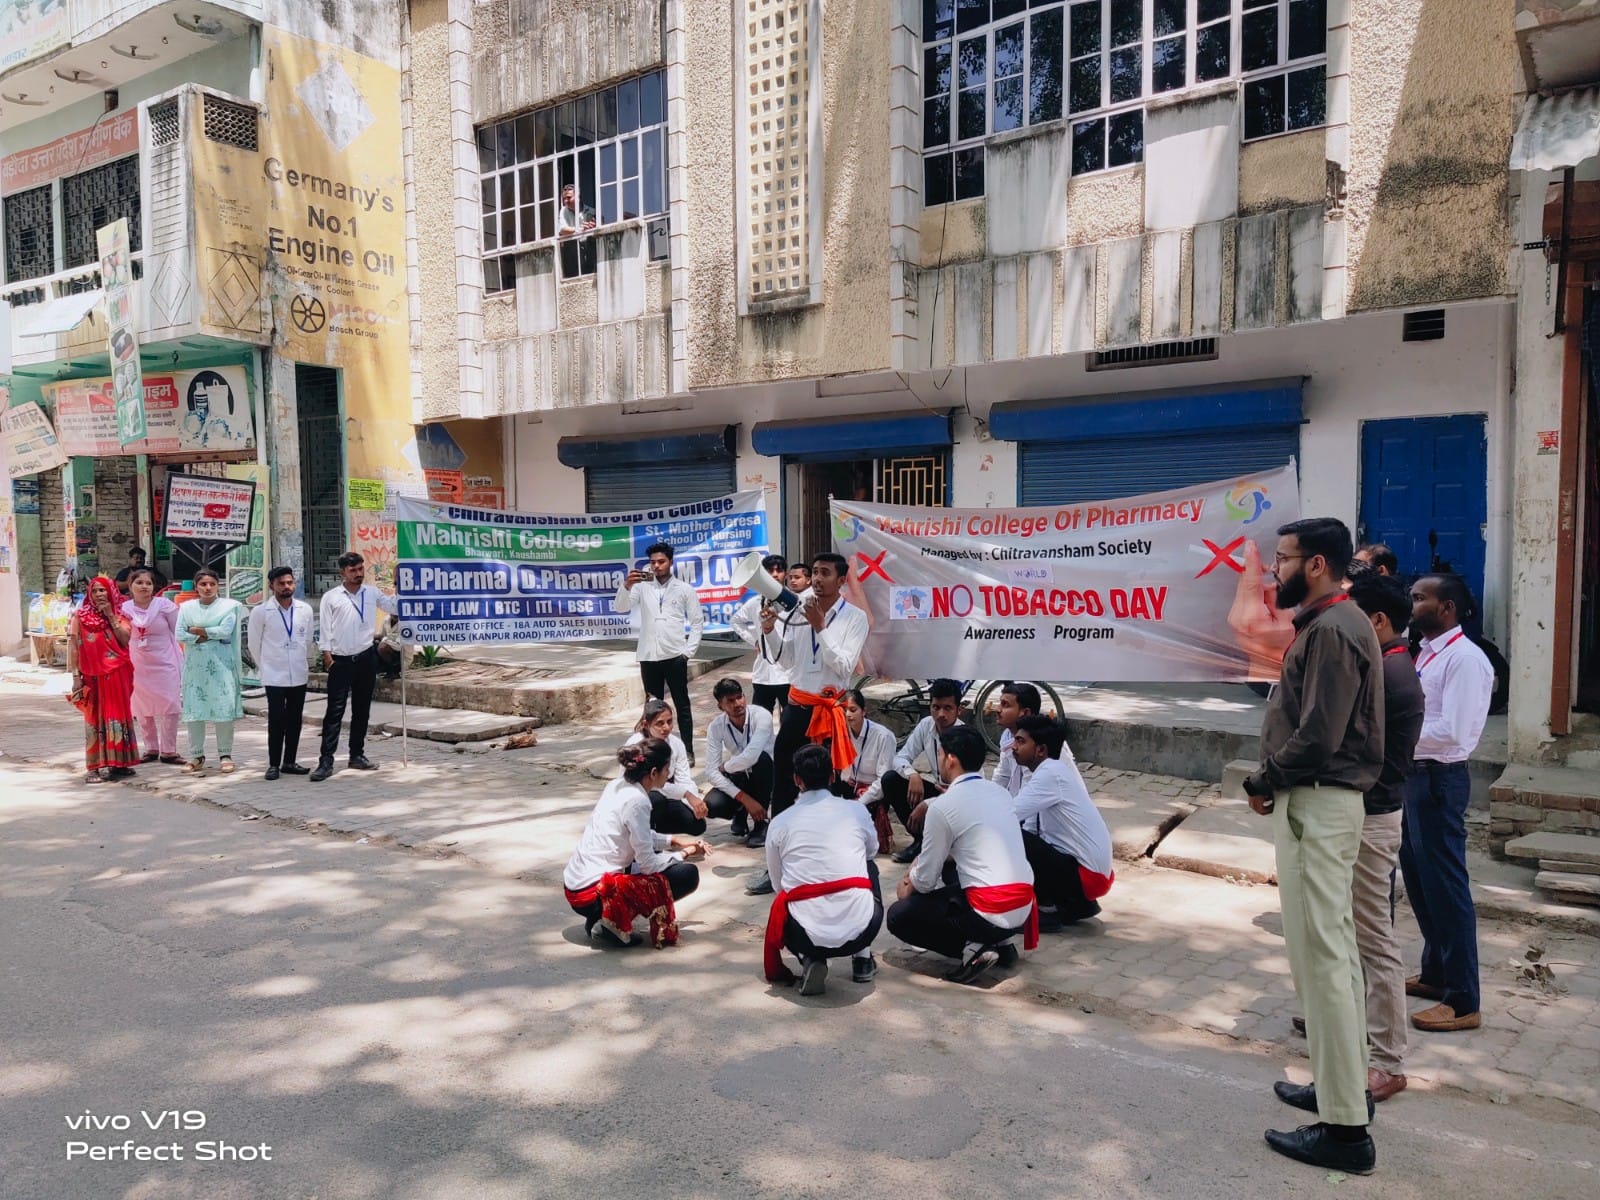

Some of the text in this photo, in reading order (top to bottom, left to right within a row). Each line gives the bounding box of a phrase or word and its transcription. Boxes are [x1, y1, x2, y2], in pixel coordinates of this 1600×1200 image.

[264, 157, 394, 212] Germany's
[308, 205, 357, 238] No.1
[269, 228, 394, 277] Engine Oil
[326, 285, 354, 297] Coolant
[448, 498, 734, 525] Chitravansham Group Of College
[876, 498, 1204, 538] Mahrishi College Of Pharmacy
[645, 514, 761, 536] St. Mother Teresa
[416, 524, 603, 552] Mahrishi College
[656, 528, 752, 546] School Of Nursing
[464, 547, 556, 560] Bharwari, Kaushambi
[920, 548, 969, 560] Managed
[970, 550, 983, 562] by
[991, 544, 1094, 560] Chitravansham
[1098, 538, 1152, 556] Society
[400, 567, 508, 591] B.Pharma
[521, 569, 625, 592] D.Pharma
[1014, 569, 1047, 578] WORLD
[402, 602, 434, 617] D.H.P
[450, 601, 480, 616] LAW
[494, 600, 520, 614] BTC
[536, 600, 552, 614] ITI
[568, 600, 594, 614] BSC
[931, 584, 1168, 621] NO TOBACCO DAY
[416, 634, 438, 642] CIVIL
[440, 633, 466, 642] LINES
[468, 632, 510, 642] (KANPUR
[512, 630, 542, 640] ROAD)
[544, 630, 594, 638] PRAYAGRAJ
[602, 628, 632, 636] 211001
[417, 622, 470, 631] CORPORATE
[474, 622, 505, 630] OFFICE
[514, 621, 530, 629] 18A
[533, 620, 556, 628] AUTO
[560, 620, 585, 628] SALES
[588, 618, 630, 626] BUILDING
[964, 624, 1115, 642] Awareness Program
